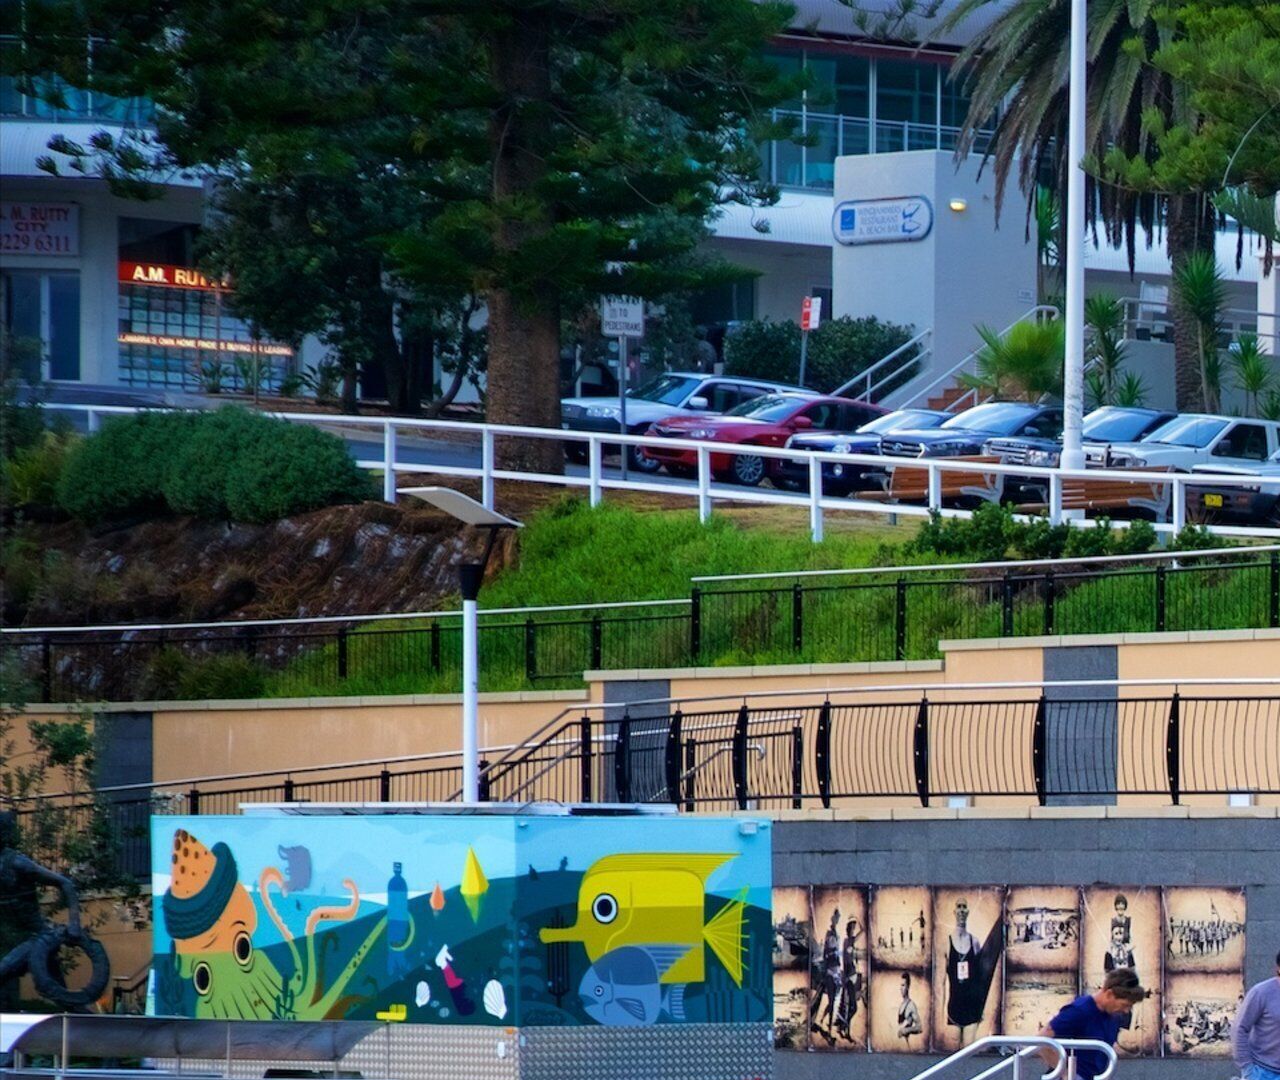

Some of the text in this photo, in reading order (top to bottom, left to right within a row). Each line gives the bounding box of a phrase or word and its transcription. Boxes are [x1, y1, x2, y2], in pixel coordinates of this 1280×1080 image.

[30, 207, 69, 222] RUTTY
[15, 222, 47, 232] CITY
[0, 233, 70, 252] 229 6311
[133, 265, 168, 283] A.M.
